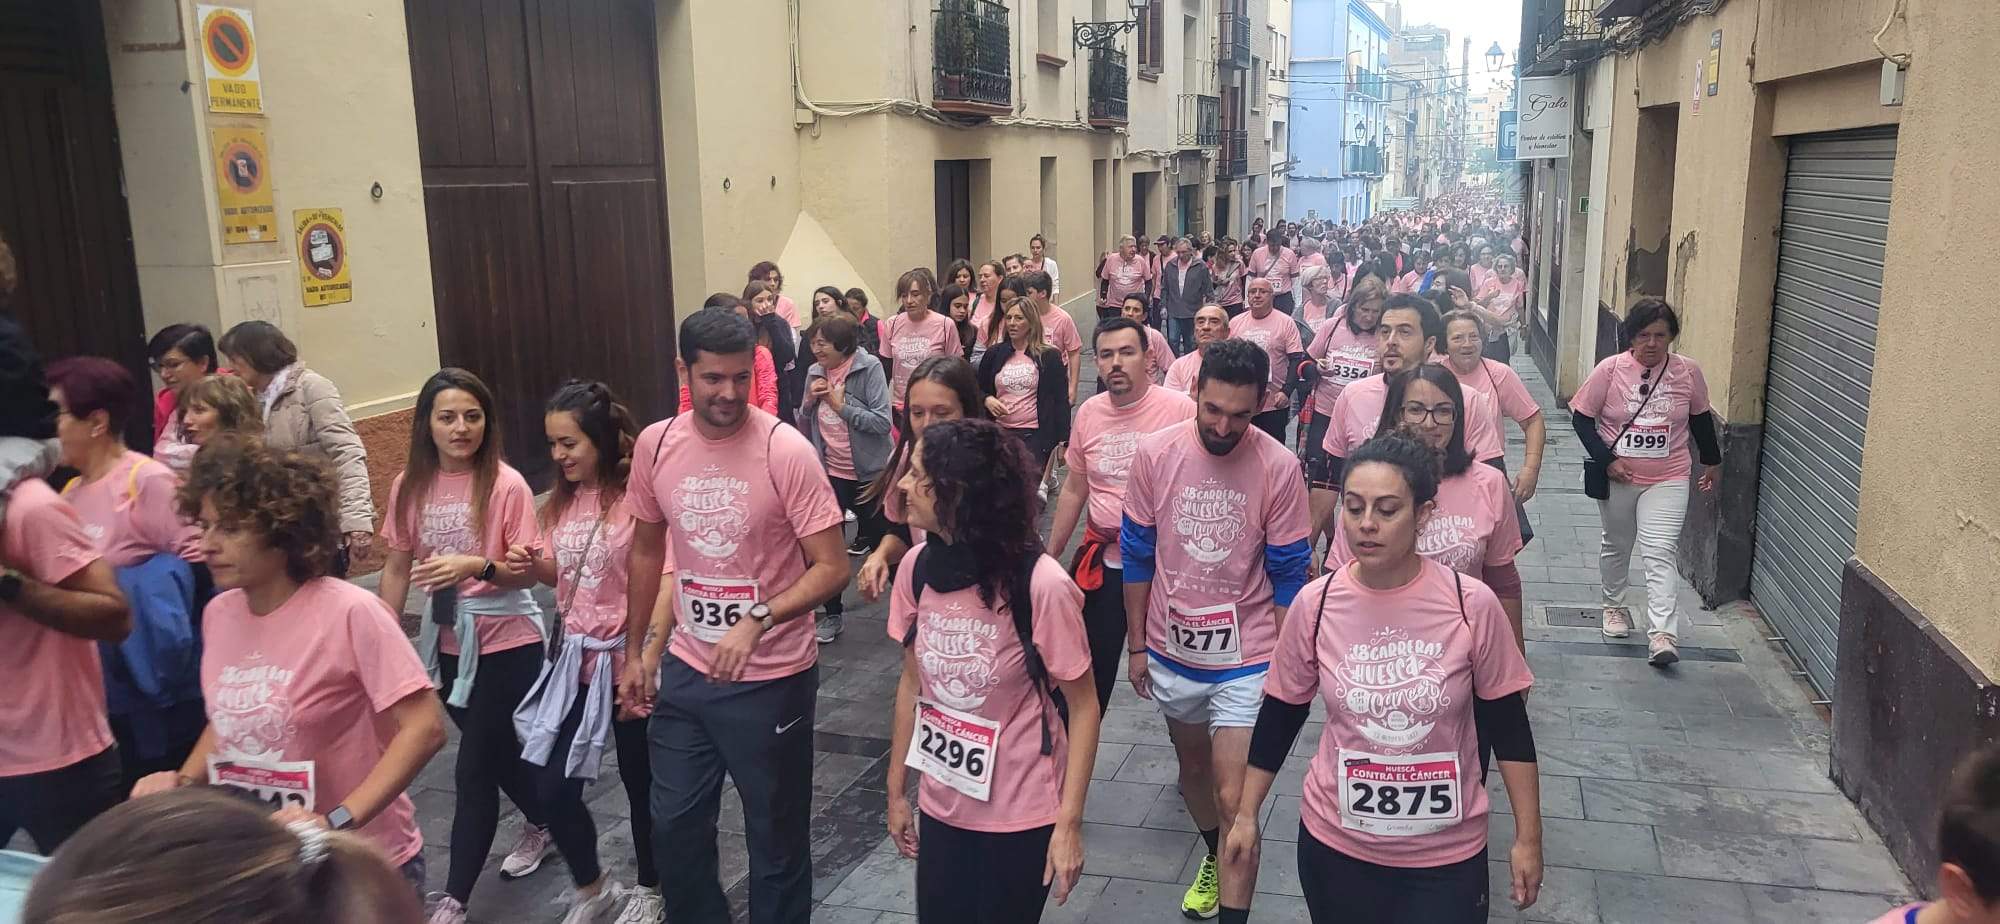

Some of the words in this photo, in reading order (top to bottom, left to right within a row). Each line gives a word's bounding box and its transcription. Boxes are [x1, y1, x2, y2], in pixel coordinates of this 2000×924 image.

[222, 82, 247, 94] VADO
[210, 96, 262, 109] PERMANENTE
[1521, 94, 1568, 122] Gala
[1334, 365, 1369, 379] 3354
[1625, 433, 1667, 449] 1999
[1417, 528, 1459, 552] UESCA
[692, 600, 742, 627] 936
[1171, 624, 1232, 651] 1277
[1354, 656, 1420, 685] HUESCA
[921, 724, 985, 777] 2296
[1352, 768, 1394, 780] CONTRA
[1396, 773, 1407, 781] EL
[1410, 769, 1451, 780] CÁNCER
[1385, 765, 1416, 773] HUESCA
[1352, 782, 1453, 815] 2875
